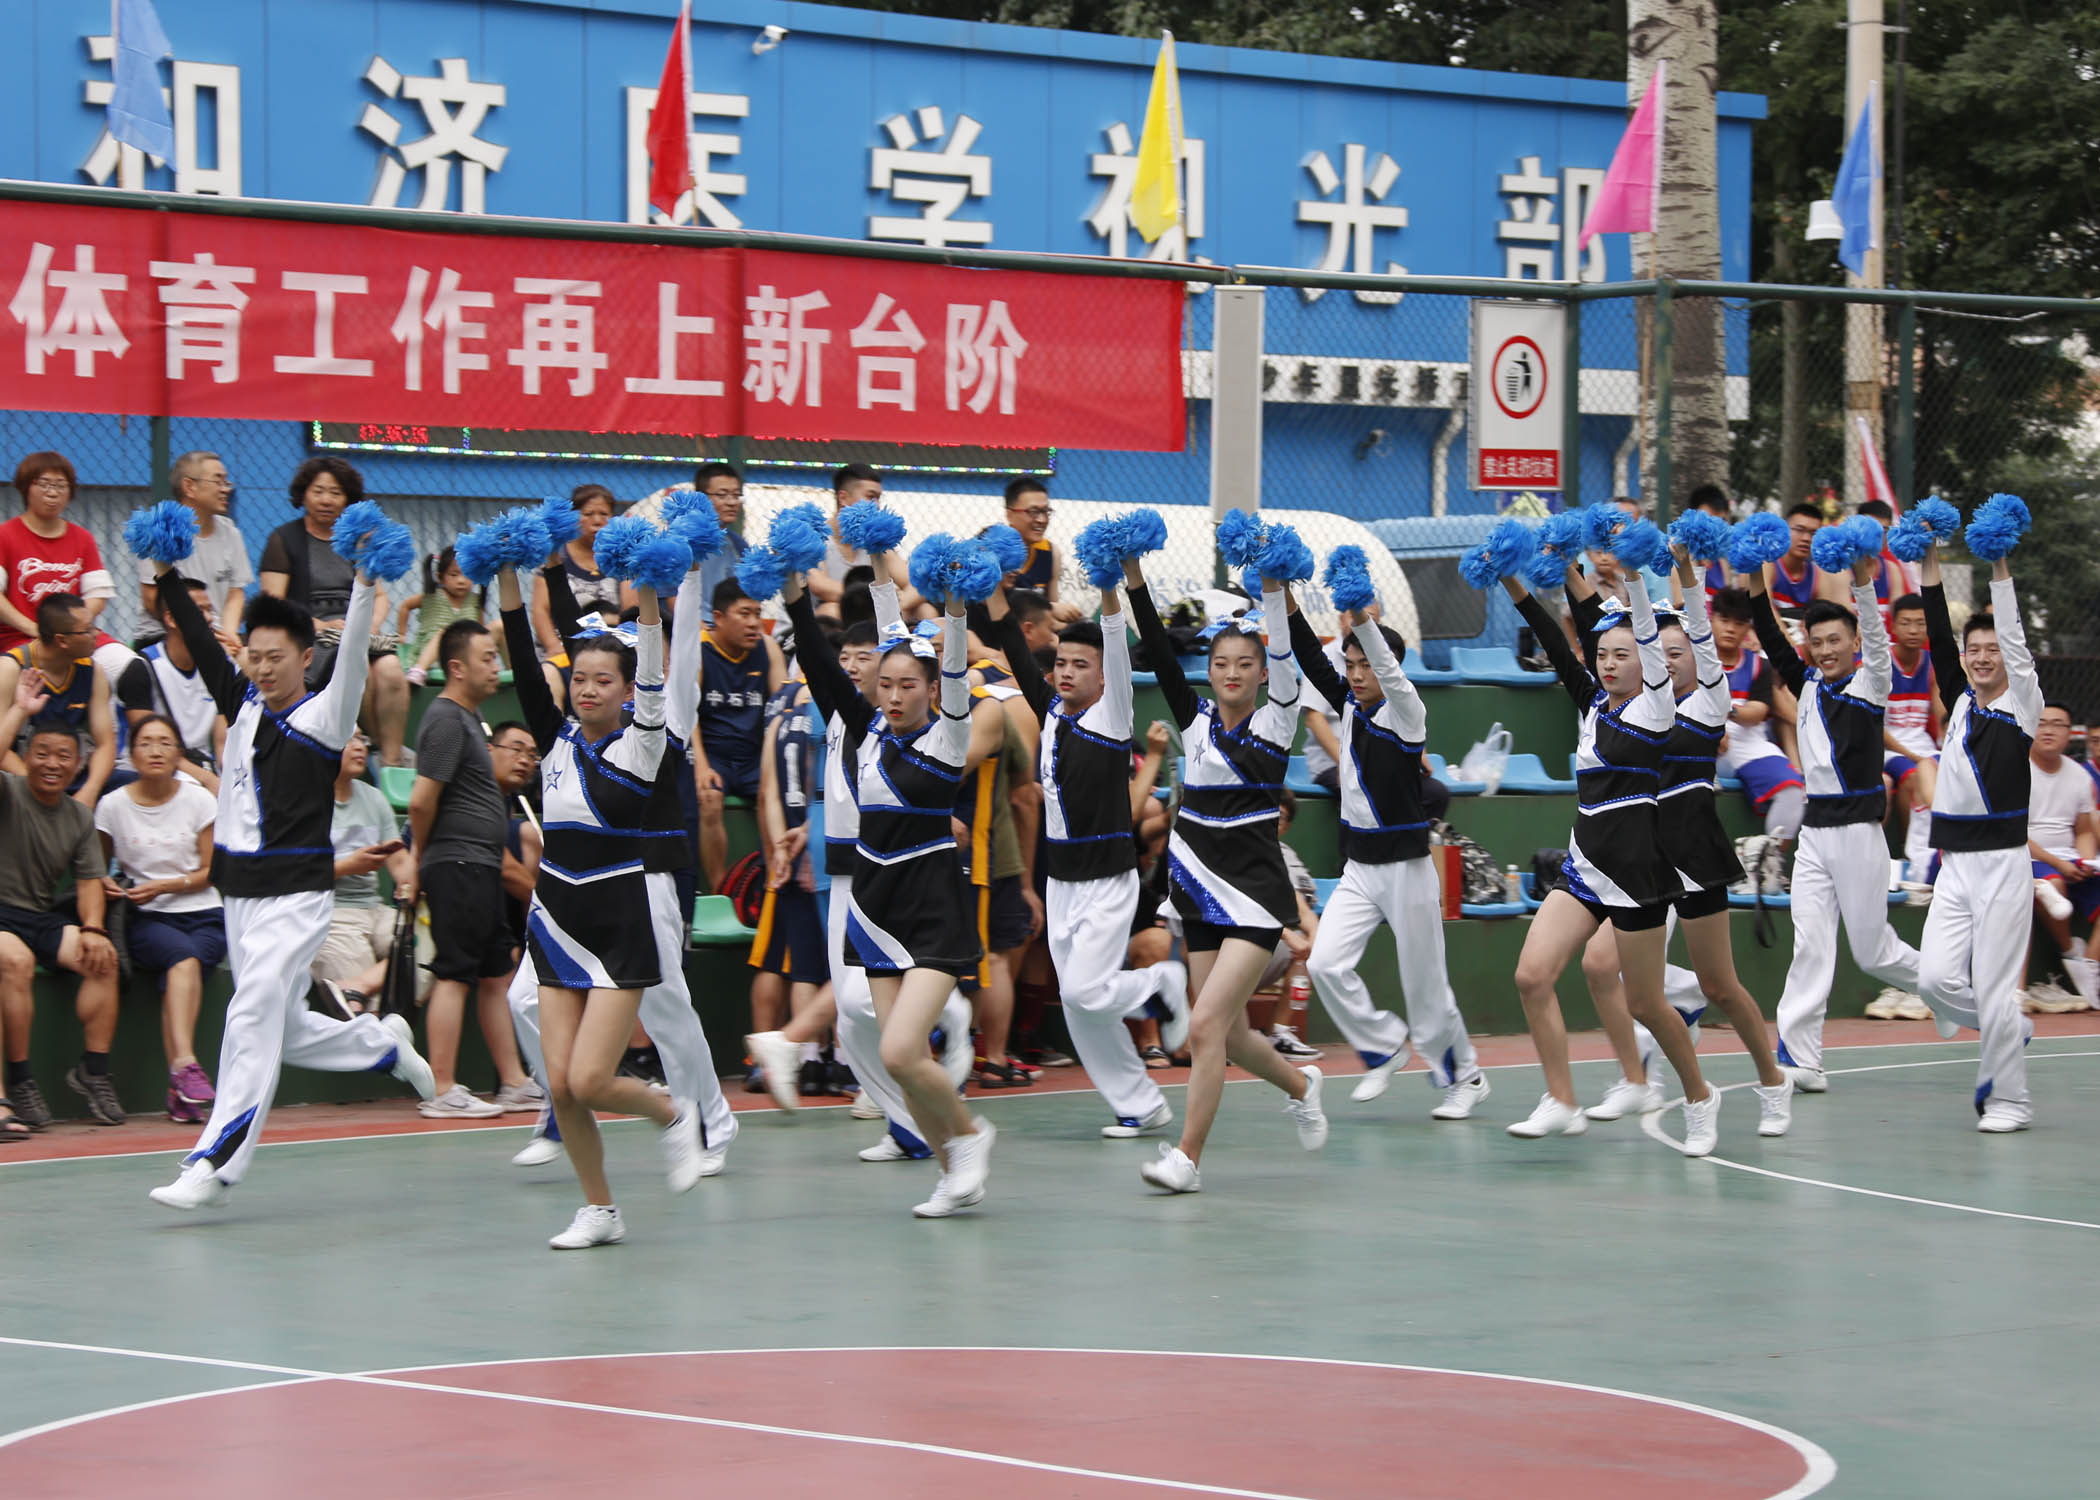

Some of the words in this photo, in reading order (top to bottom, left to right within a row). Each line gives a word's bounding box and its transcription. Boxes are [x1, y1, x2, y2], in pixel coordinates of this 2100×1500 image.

[10, 241, 1029, 416] 体育工作再上新台阶
[706, 689, 763, 707] 中石油
